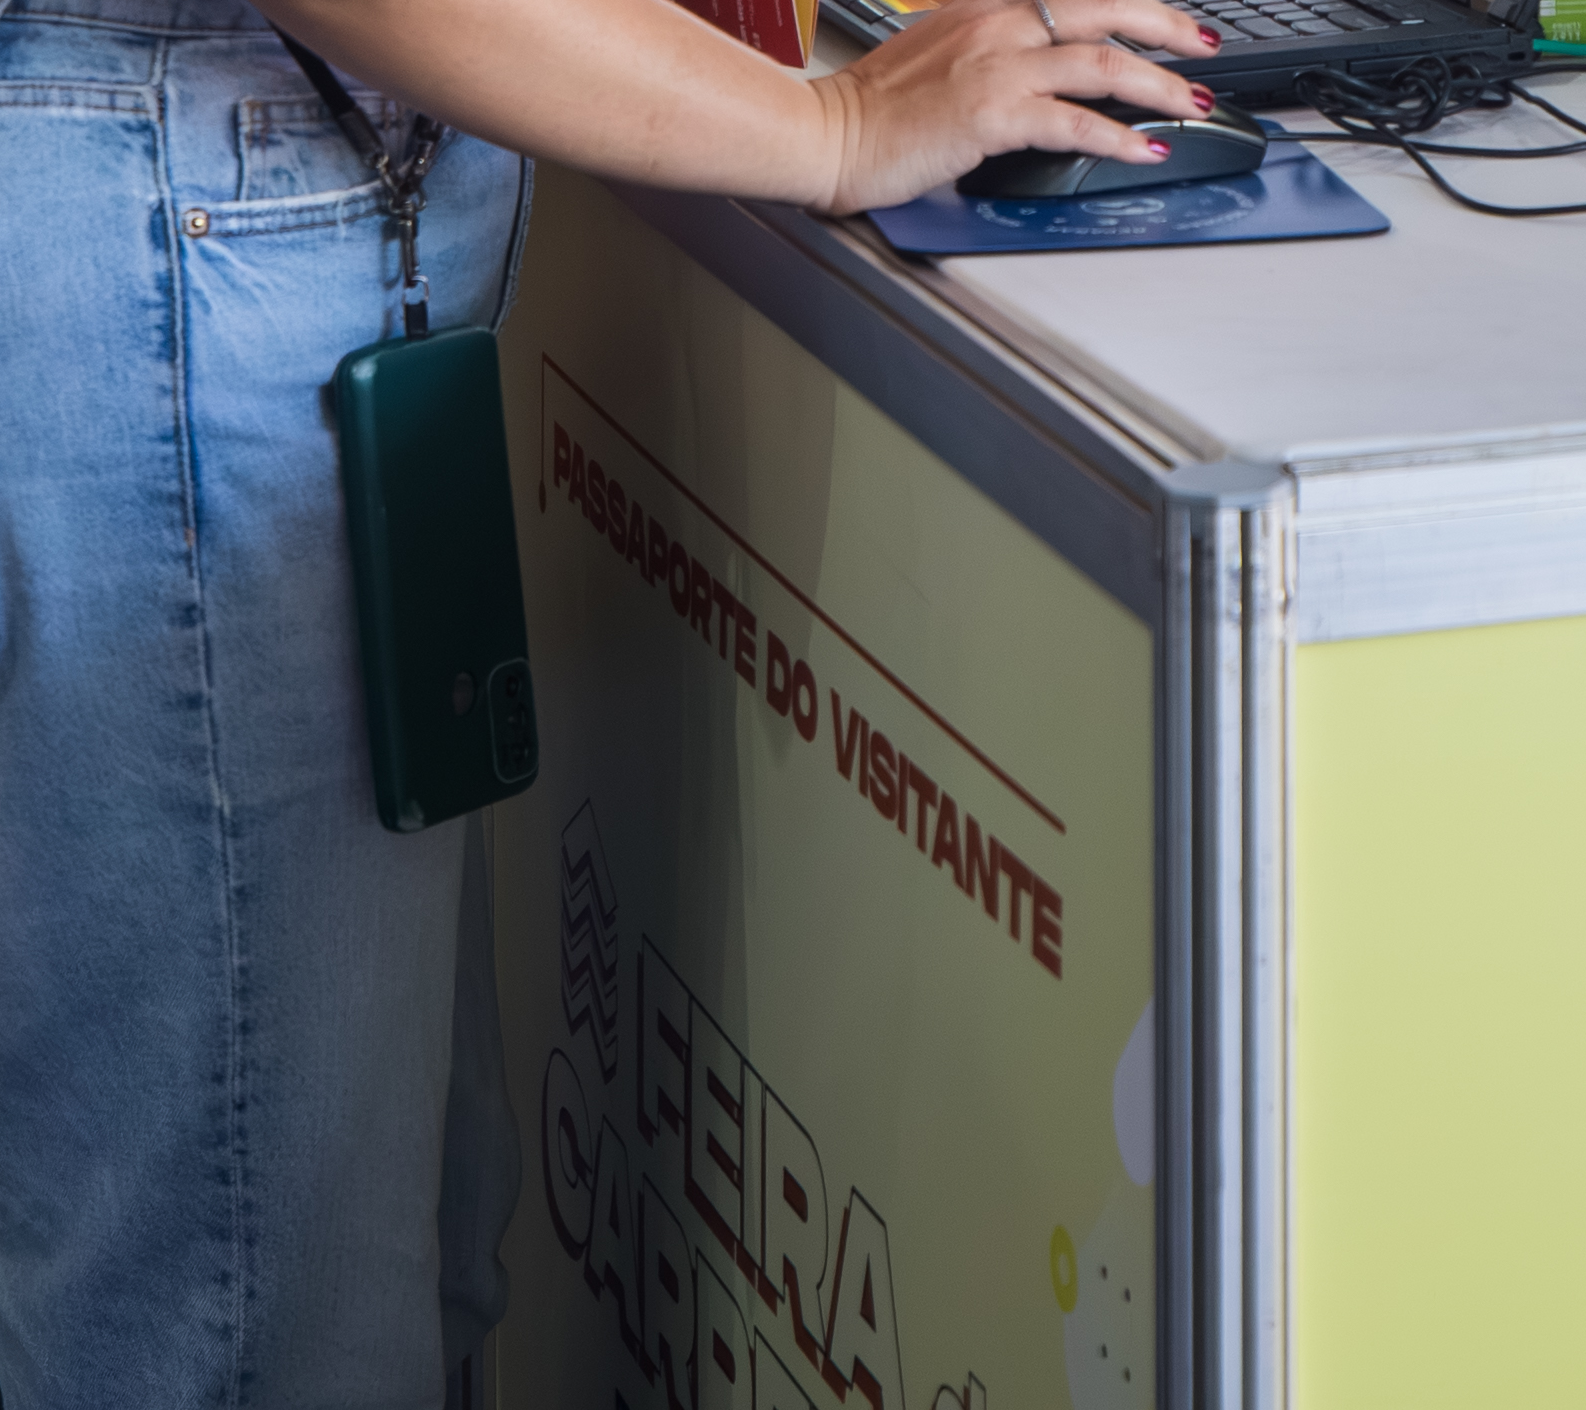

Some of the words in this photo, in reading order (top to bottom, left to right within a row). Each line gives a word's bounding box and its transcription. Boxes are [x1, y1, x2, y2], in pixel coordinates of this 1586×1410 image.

[553, 419, 758, 690] PASSAPORTE
[766, 629, 818, 744] DO
[830, 686, 1064, 981] VISITANTE
